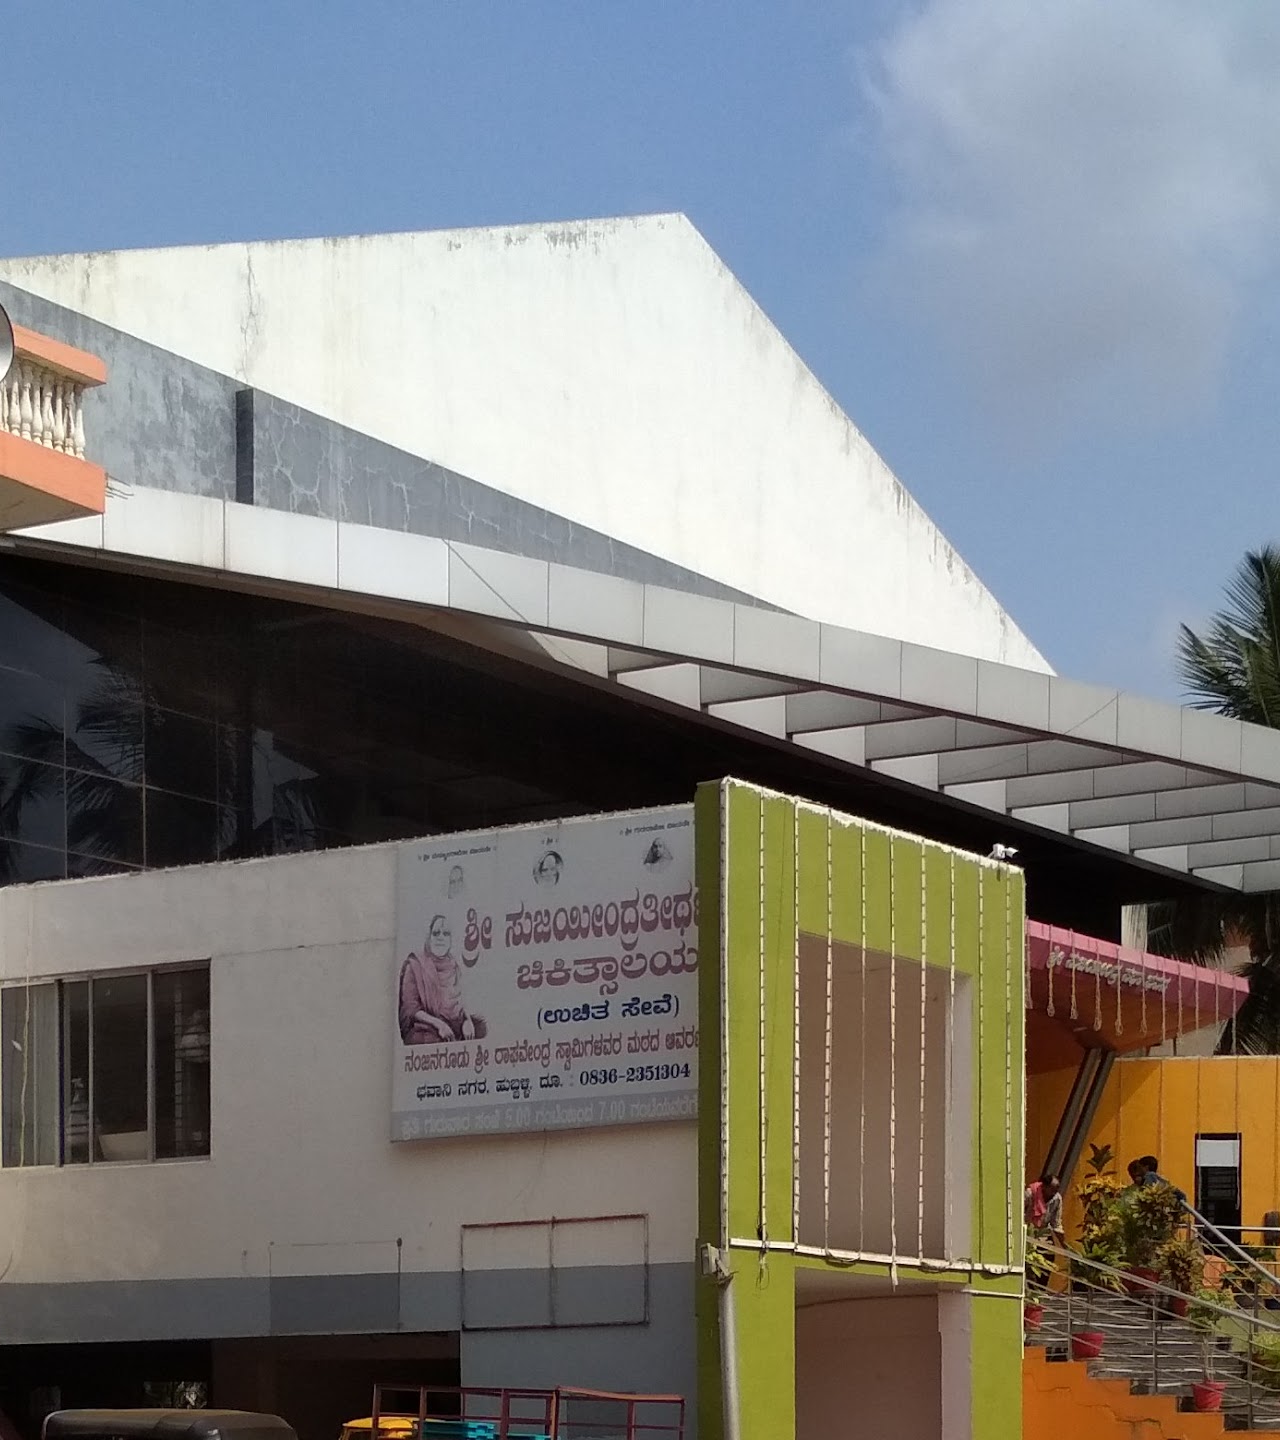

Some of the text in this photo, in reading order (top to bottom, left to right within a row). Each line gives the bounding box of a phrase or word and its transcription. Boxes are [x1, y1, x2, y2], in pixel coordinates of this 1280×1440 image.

[462, 907, 493, 968] ಶ್ರೀ
[517, 940, 699, 996] ಚಿಕಿತ್ಸಾಲಯ
[579, 1063, 691, 1086] 0836-2351304
